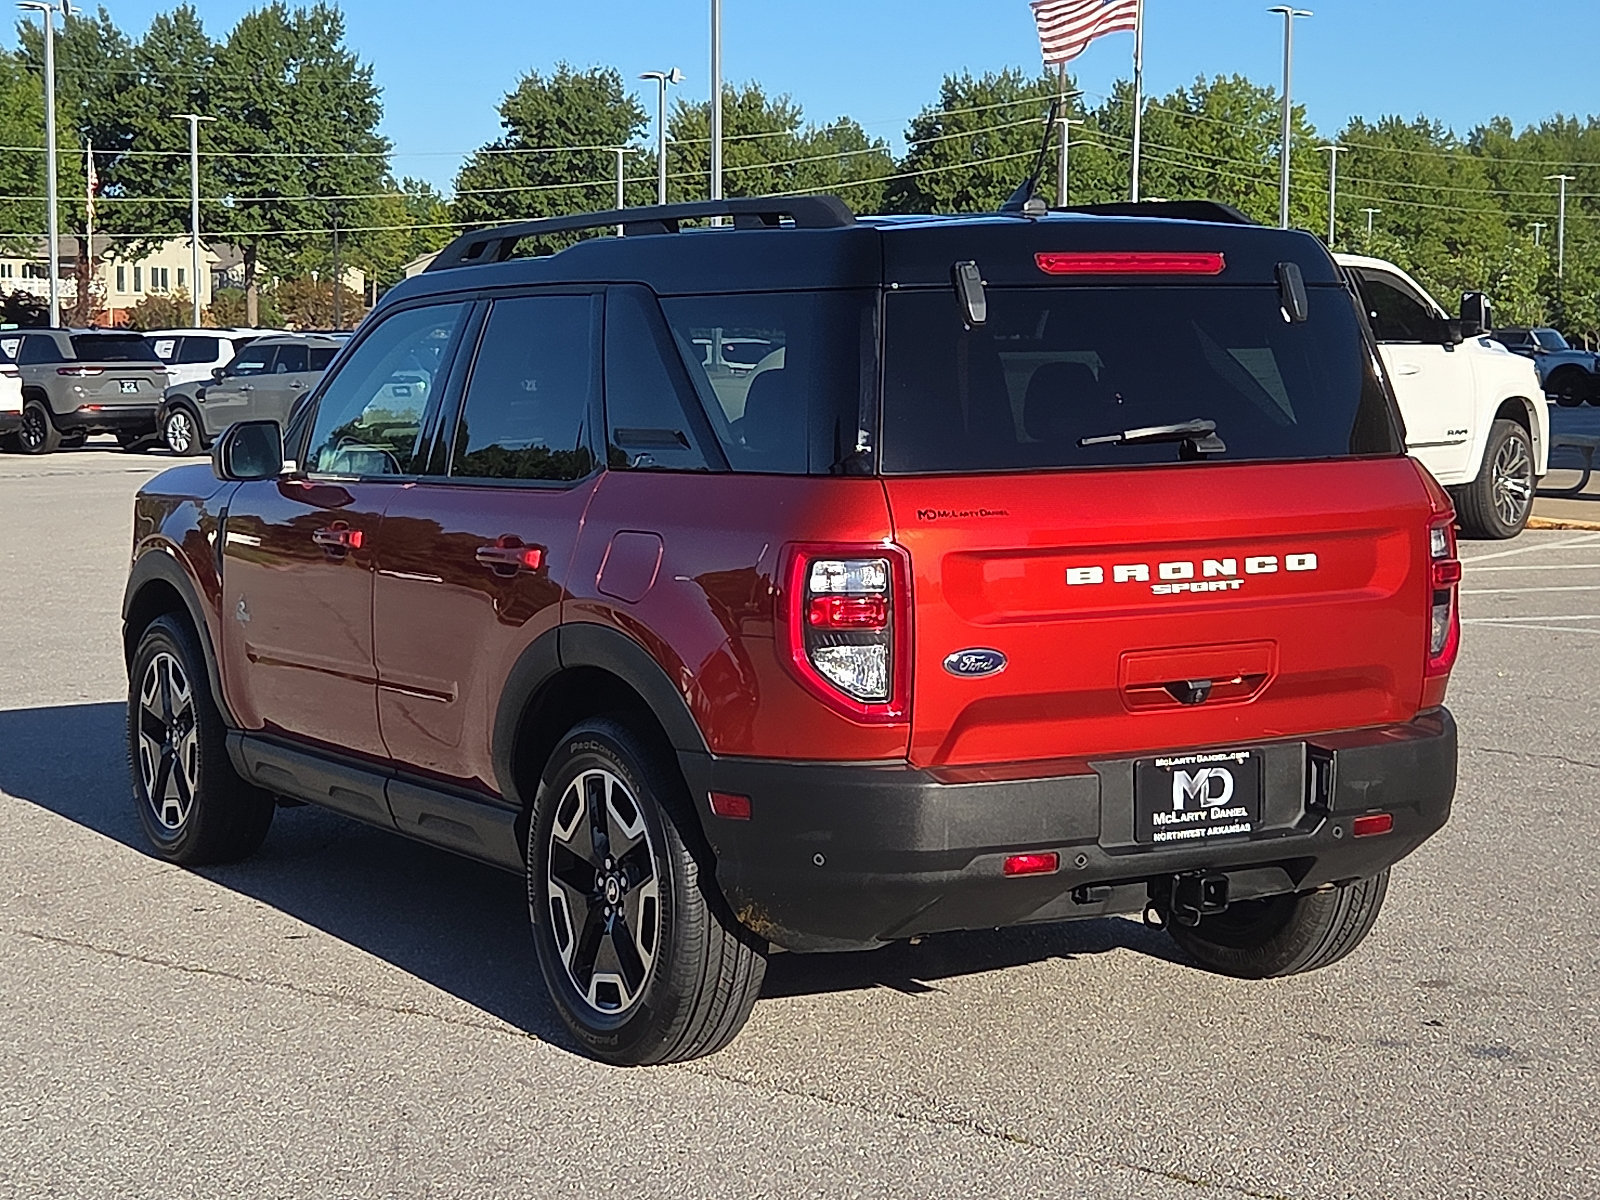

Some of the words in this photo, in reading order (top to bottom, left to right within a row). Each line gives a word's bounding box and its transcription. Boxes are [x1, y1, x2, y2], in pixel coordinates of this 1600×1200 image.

[1066, 553, 1318, 585] BRONCO
[1151, 579, 1244, 594] SPORT
[960, 655, 993, 672] Ford
[1173, 767, 1234, 810] MD
[1153, 828, 1206, 842] NORTHWEST
[1207, 823, 1251, 836] ARKANSAS
